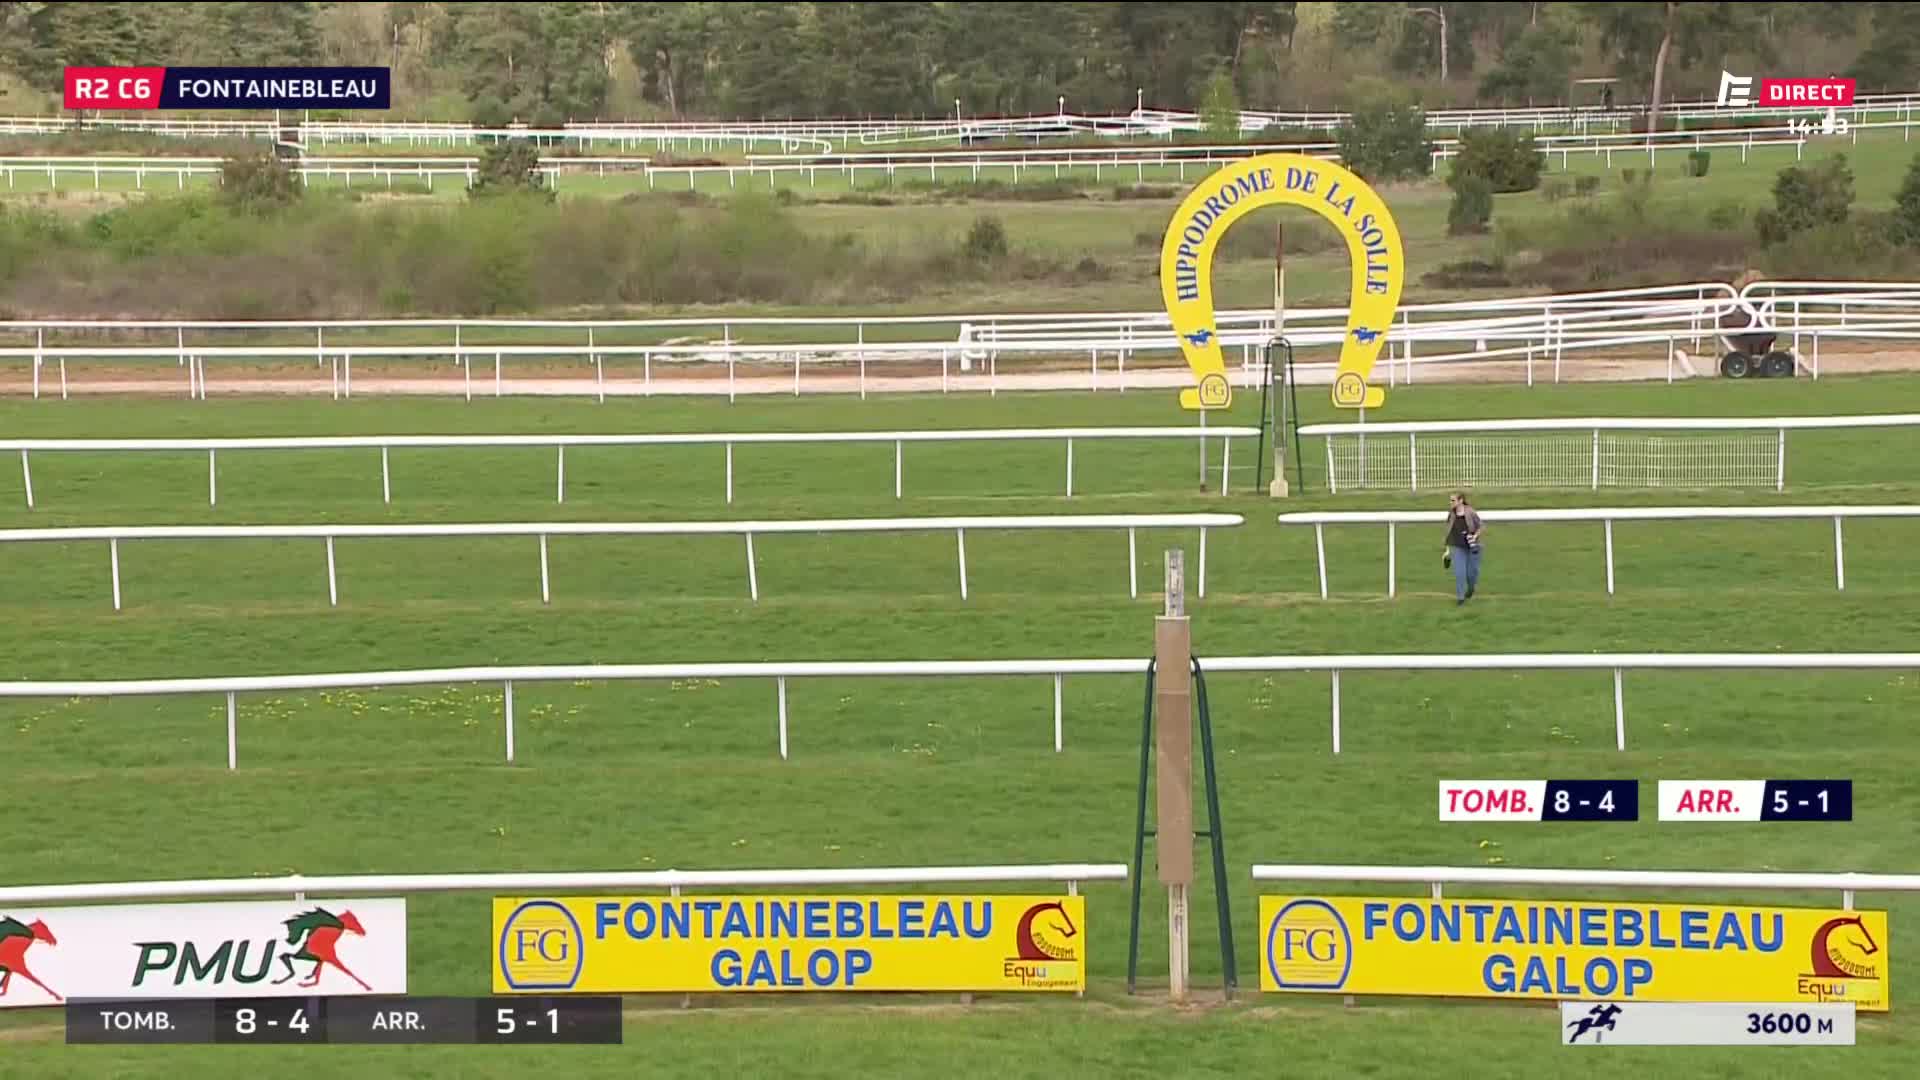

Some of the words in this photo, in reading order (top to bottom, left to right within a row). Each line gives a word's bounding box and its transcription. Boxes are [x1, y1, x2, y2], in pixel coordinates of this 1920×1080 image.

[1176, 167, 1275, 302] HIPPODROME
[1286, 167, 1320, 193] DE
[1325, 181, 1356, 216] LA
[1354, 214, 1389, 295] SOLLE
[1205, 383, 1225, 397] FG
[1341, 382, 1360, 396] FG
[596, 901, 993, 939] FONTAINEBLEAU
[1364, 903, 1784, 952] FONTAINEBLEAU
[132, 939, 277, 987] PMU
[513, 929, 568, 962] FG
[1281, 928, 1336, 961] FG
[711, 949, 873, 987] GALOP
[1483, 954, 1653, 997] GALOP
